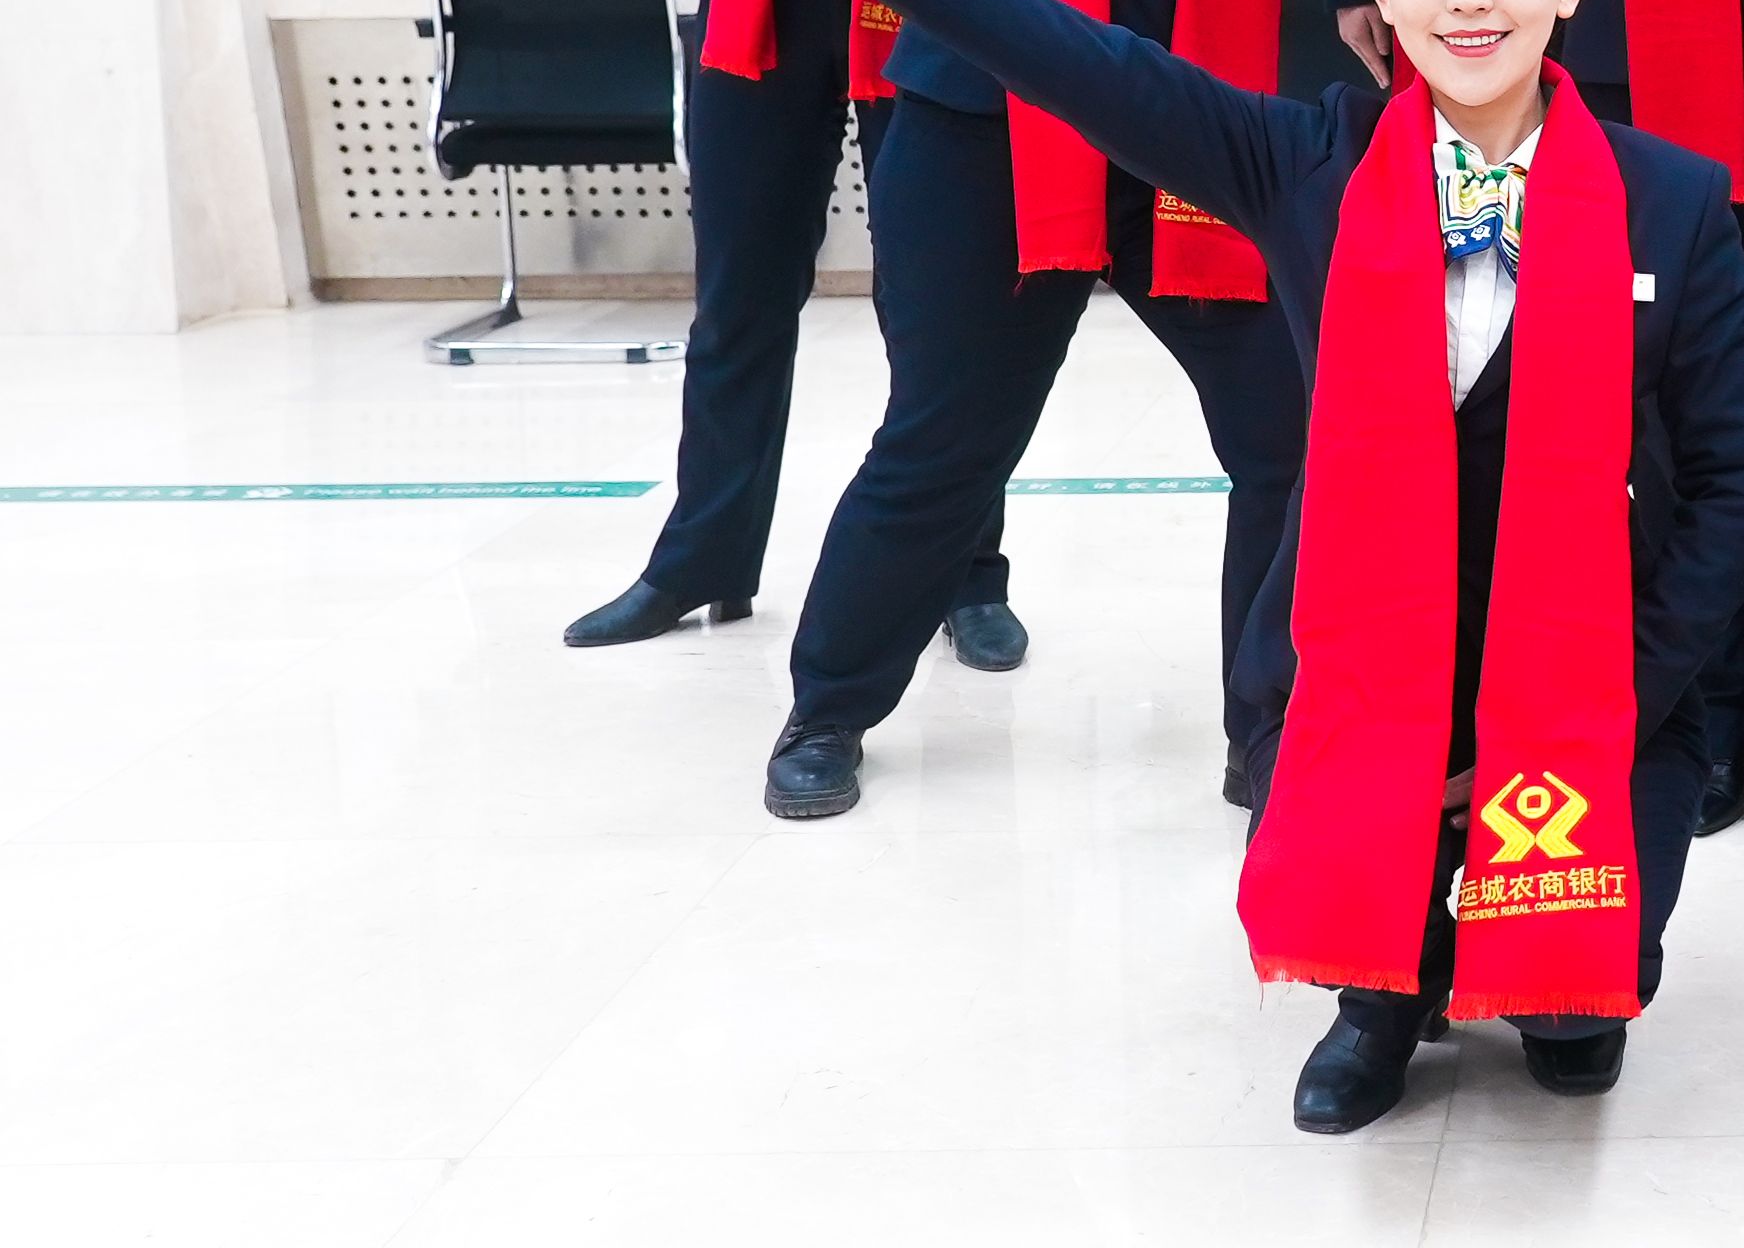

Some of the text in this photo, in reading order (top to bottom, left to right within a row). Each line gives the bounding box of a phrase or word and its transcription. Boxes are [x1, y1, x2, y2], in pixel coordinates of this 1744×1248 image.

[1458, 866, 1627, 908] 运城农商银行
[1501, 903, 1531, 917] RURAL
[1534, 897, 1596, 913] COMMERCIAL
[1601, 896, 1627, 908] BANK
